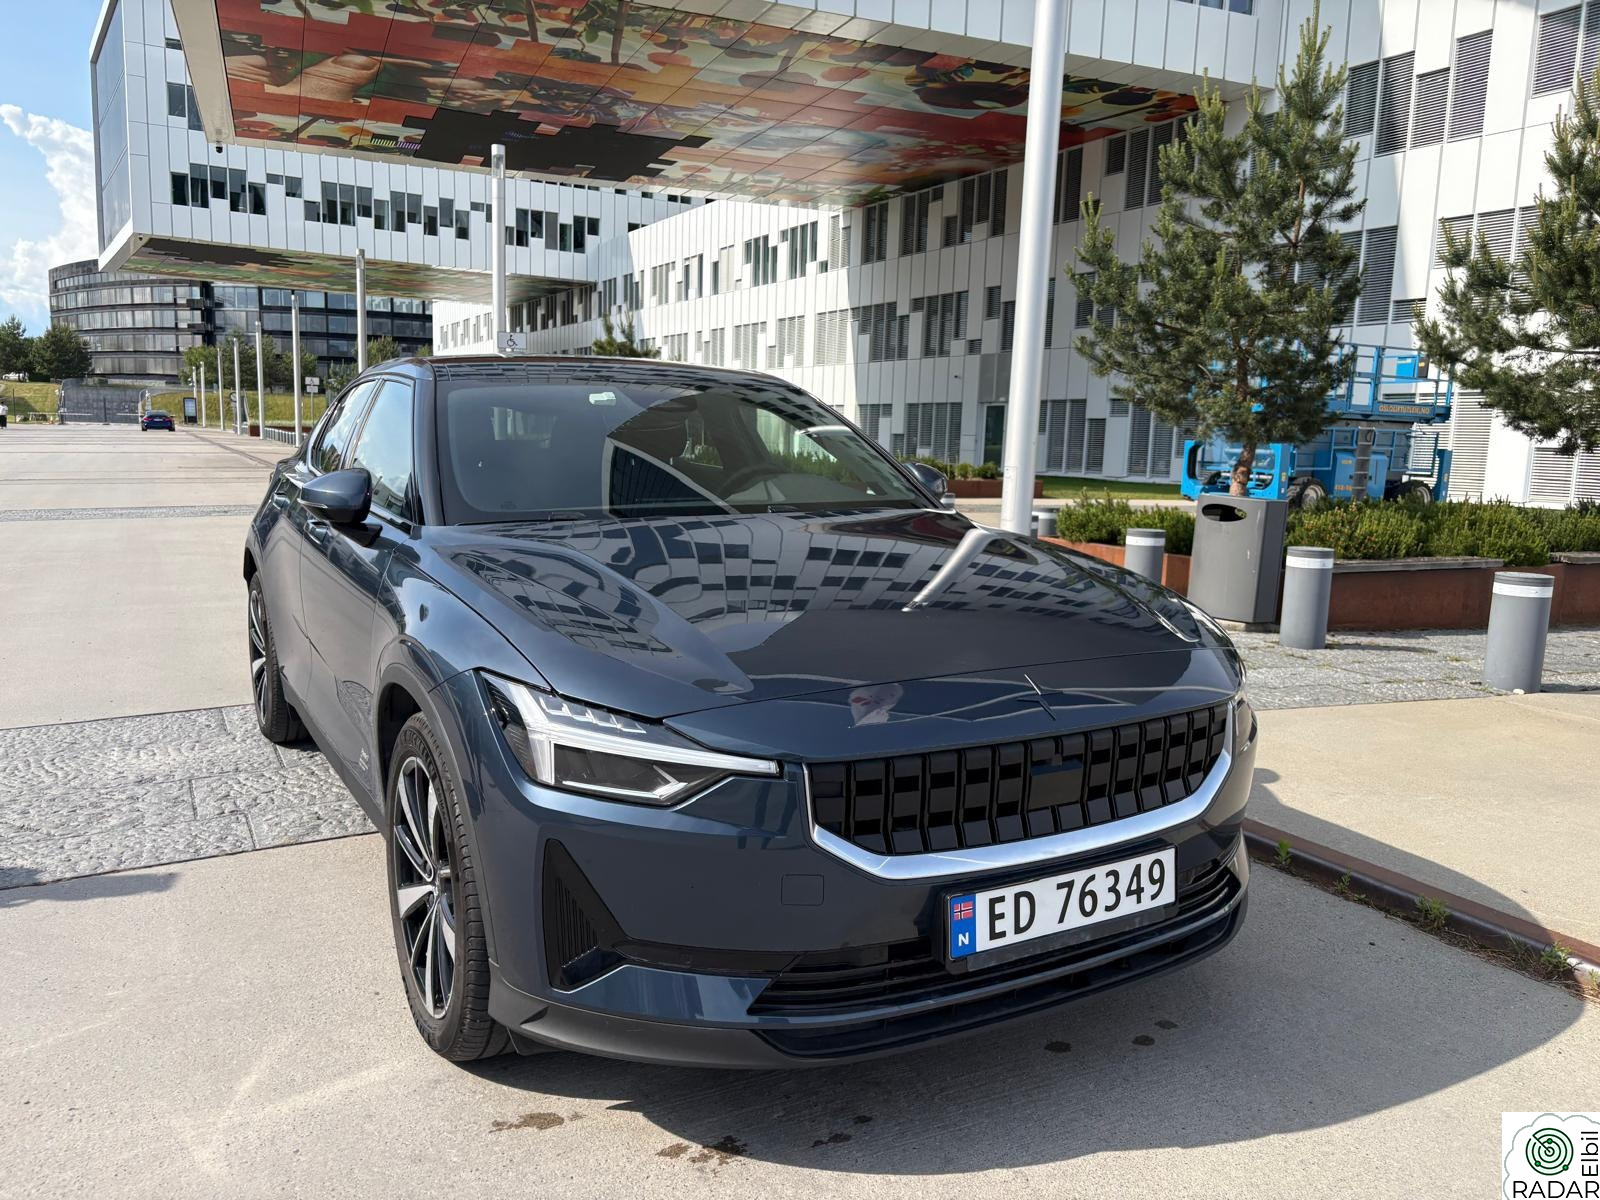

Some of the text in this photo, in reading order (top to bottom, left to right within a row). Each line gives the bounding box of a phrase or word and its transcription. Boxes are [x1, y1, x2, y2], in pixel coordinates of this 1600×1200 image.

[988, 858, 1166, 941] ED 76349
[958, 932, 969, 947] N
